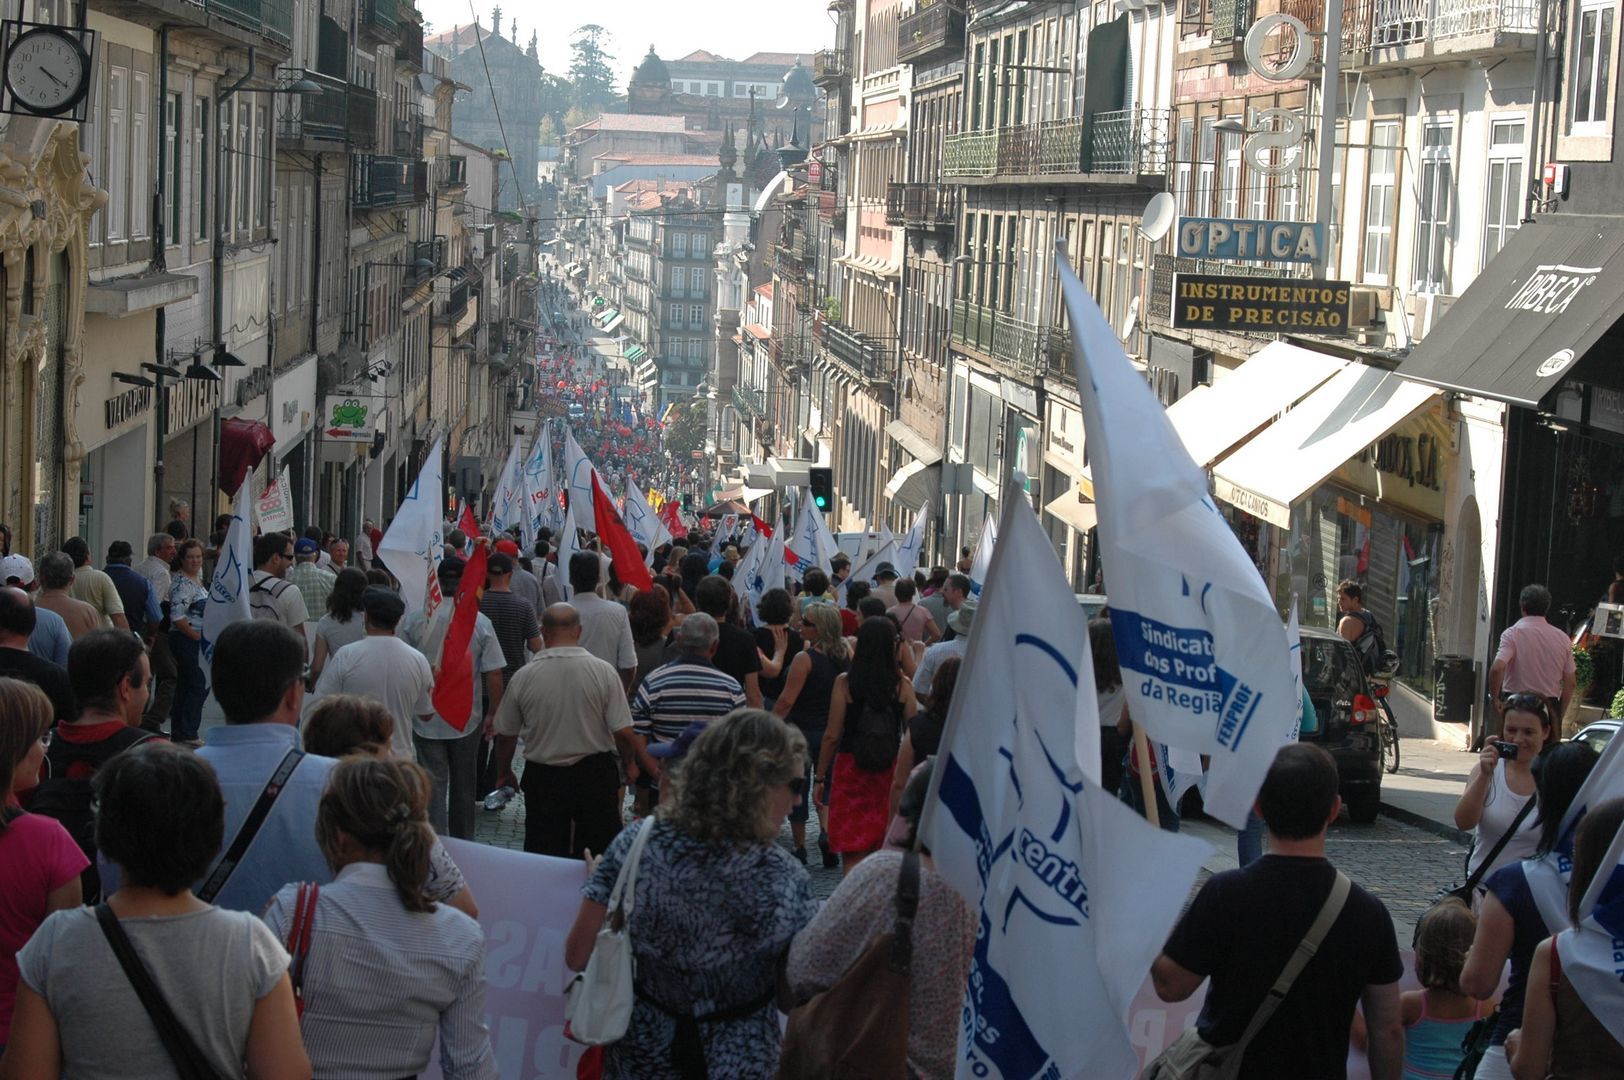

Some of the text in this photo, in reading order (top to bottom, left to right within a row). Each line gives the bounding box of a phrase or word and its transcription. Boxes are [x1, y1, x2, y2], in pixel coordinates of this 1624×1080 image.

[1181, 220, 1318, 259] ÓPTICA
[1181, 282, 1348, 304] INSTRUMENTOS
[1186, 305, 1341, 328] DE PRECISÃO
[167, 378, 220, 434] BRUXELAS
[1141, 678, 1164, 700] da
[1217, 683, 1253, 747] FENPROF
